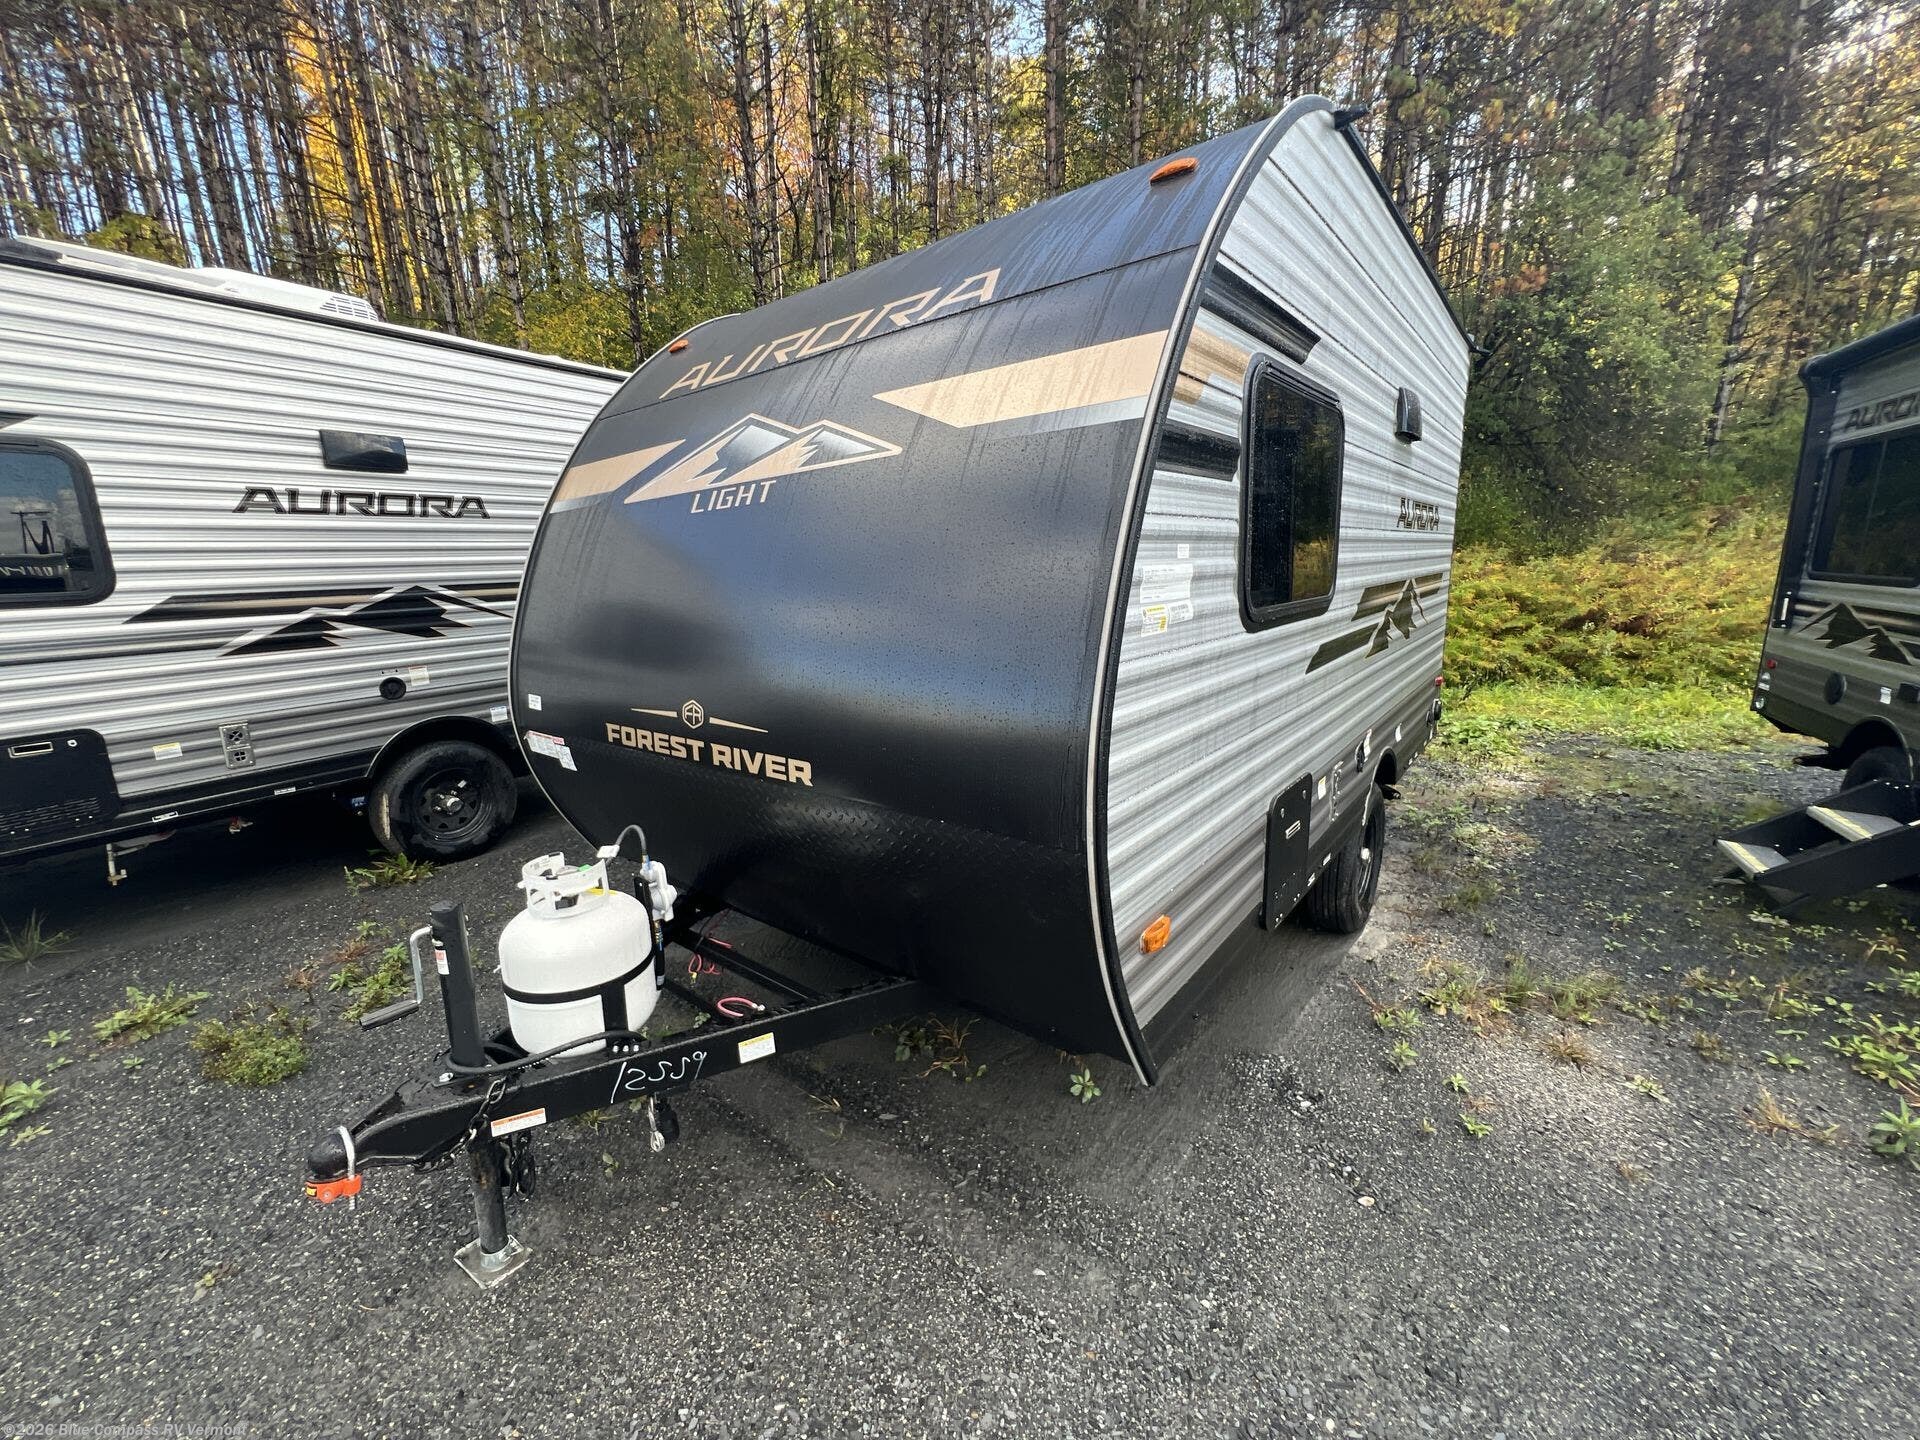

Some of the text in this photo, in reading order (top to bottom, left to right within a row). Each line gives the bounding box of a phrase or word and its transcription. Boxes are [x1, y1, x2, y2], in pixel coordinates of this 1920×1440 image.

[658, 268, 1001, 399] AURORA
[231, 486, 491, 519] AURORA
[690, 480, 777, 514] LIGHT
[1396, 496, 1440, 531] AURORA
[605, 722, 705, 762] FOREST
[710, 742, 813, 787] RIVER
[610, 1051, 708, 1104] 12559
